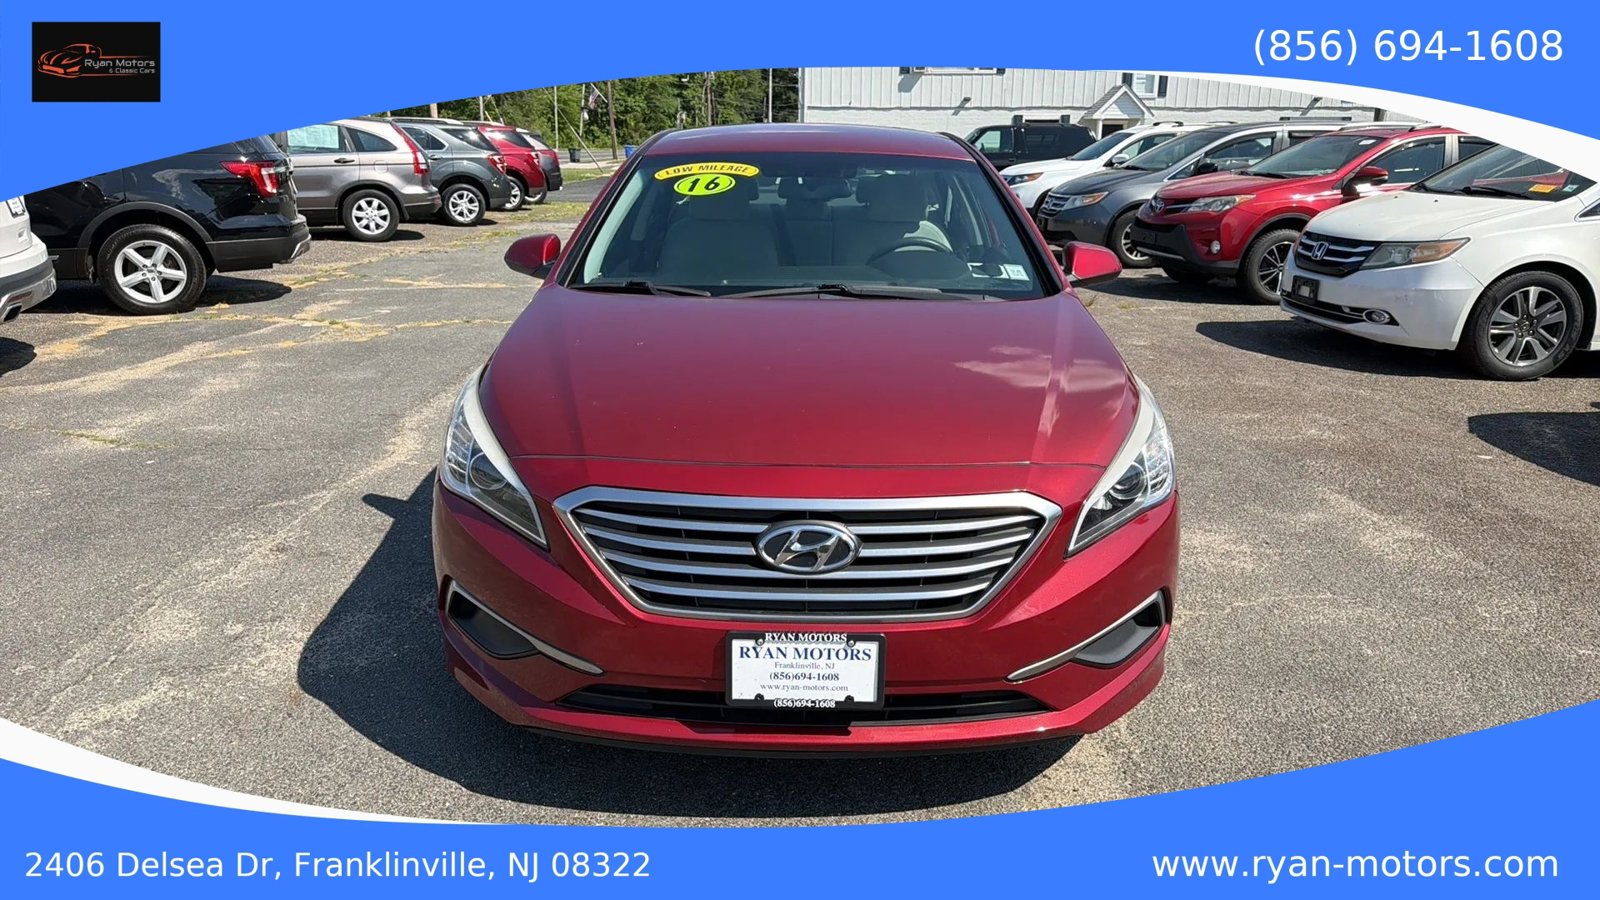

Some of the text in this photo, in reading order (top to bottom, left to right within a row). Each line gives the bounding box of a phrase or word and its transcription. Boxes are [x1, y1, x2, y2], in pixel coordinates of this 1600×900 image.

[665, 164, 749, 176] LOW MILEAGE
[687, 176, 721, 192] 16
[764, 632, 848, 643] RYAN MOTORS
[739, 646, 872, 661] RYAN MOTORS
[774, 661, 835, 670] Franklinville, NJ
[769, 672, 840, 682] (856)694-1608
[760, 683, 849, 693] www.ryan-motors.com
[773, 698, 836, 708] (856)694-1608
